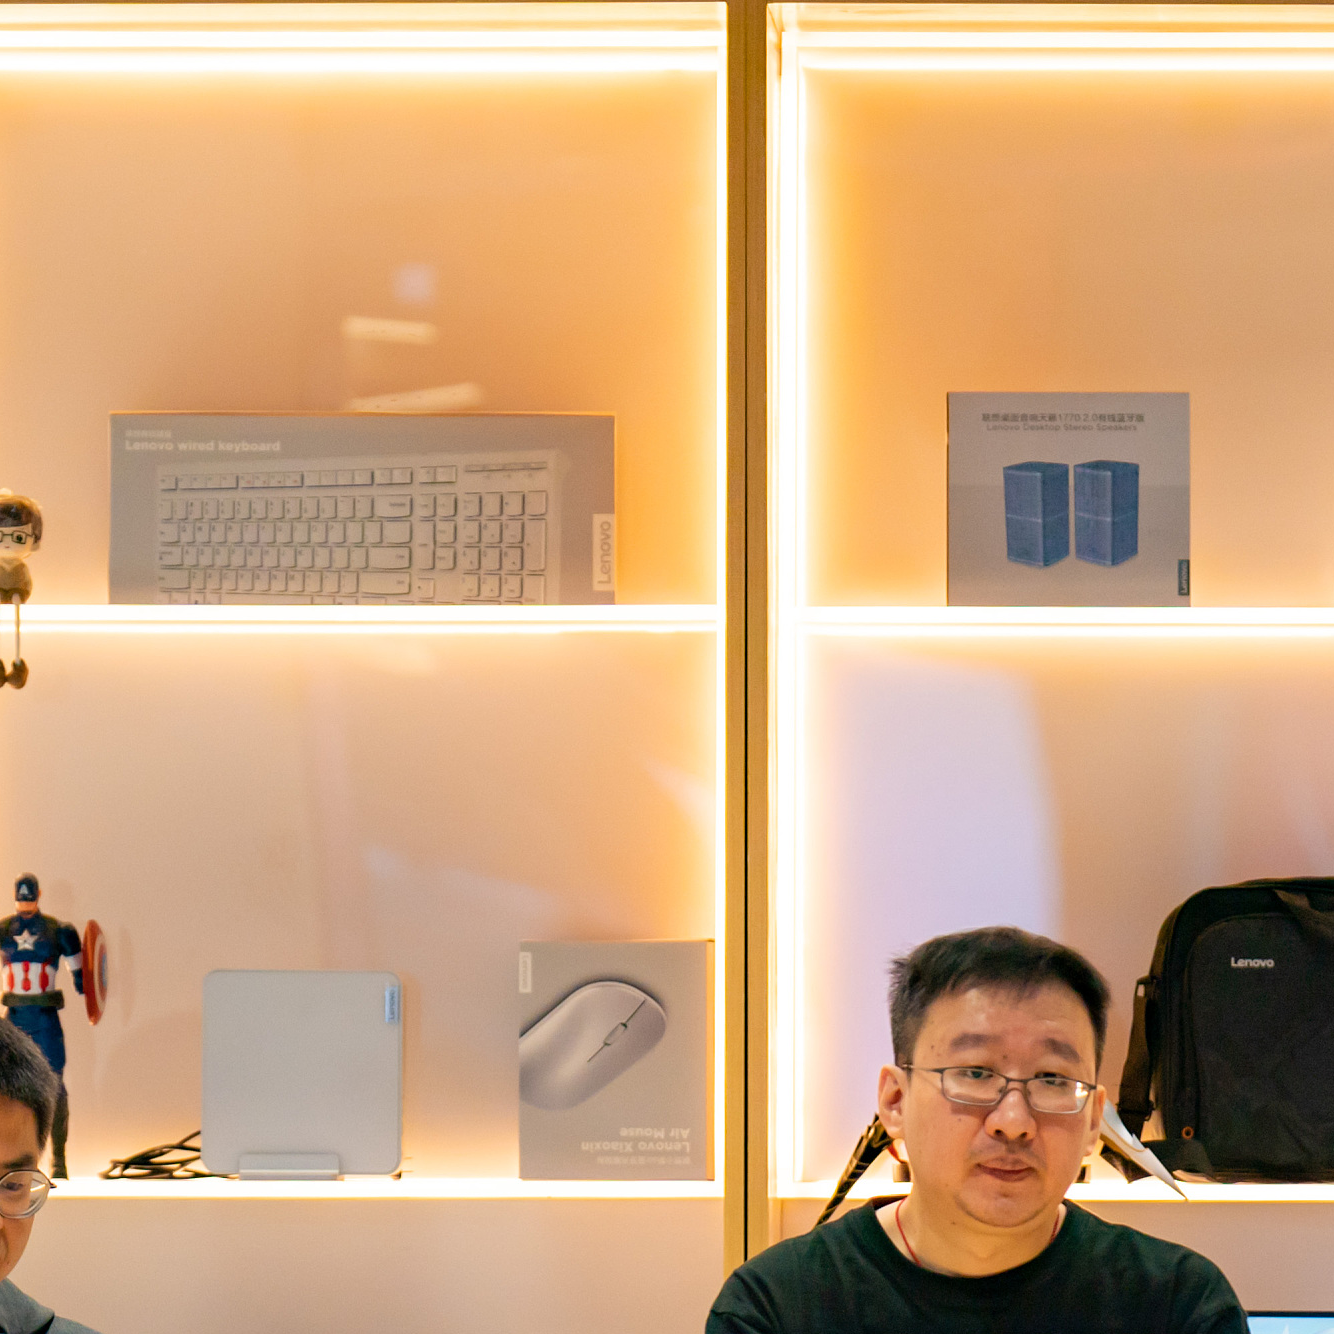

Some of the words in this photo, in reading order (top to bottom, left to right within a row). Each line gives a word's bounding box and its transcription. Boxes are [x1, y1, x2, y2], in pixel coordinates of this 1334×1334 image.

[1023, 424, 1061, 432] Desktop
[1097, 424, 1137, 432] Speakers
[125, 440, 174, 450] Lenovo
[177, 440, 214, 450] wired
[218, 440, 280, 453] keyboard
[597, 521, 612, 584] Lenovo
[1230, 956, 1276, 968] Lenovo
[618, 1127, 665, 1139] Mouse
[669, 1127, 691, 1139] Air
[580, 1140, 634, 1153] Xiaoxin
[637, 1140, 690, 1153] Lenovo
